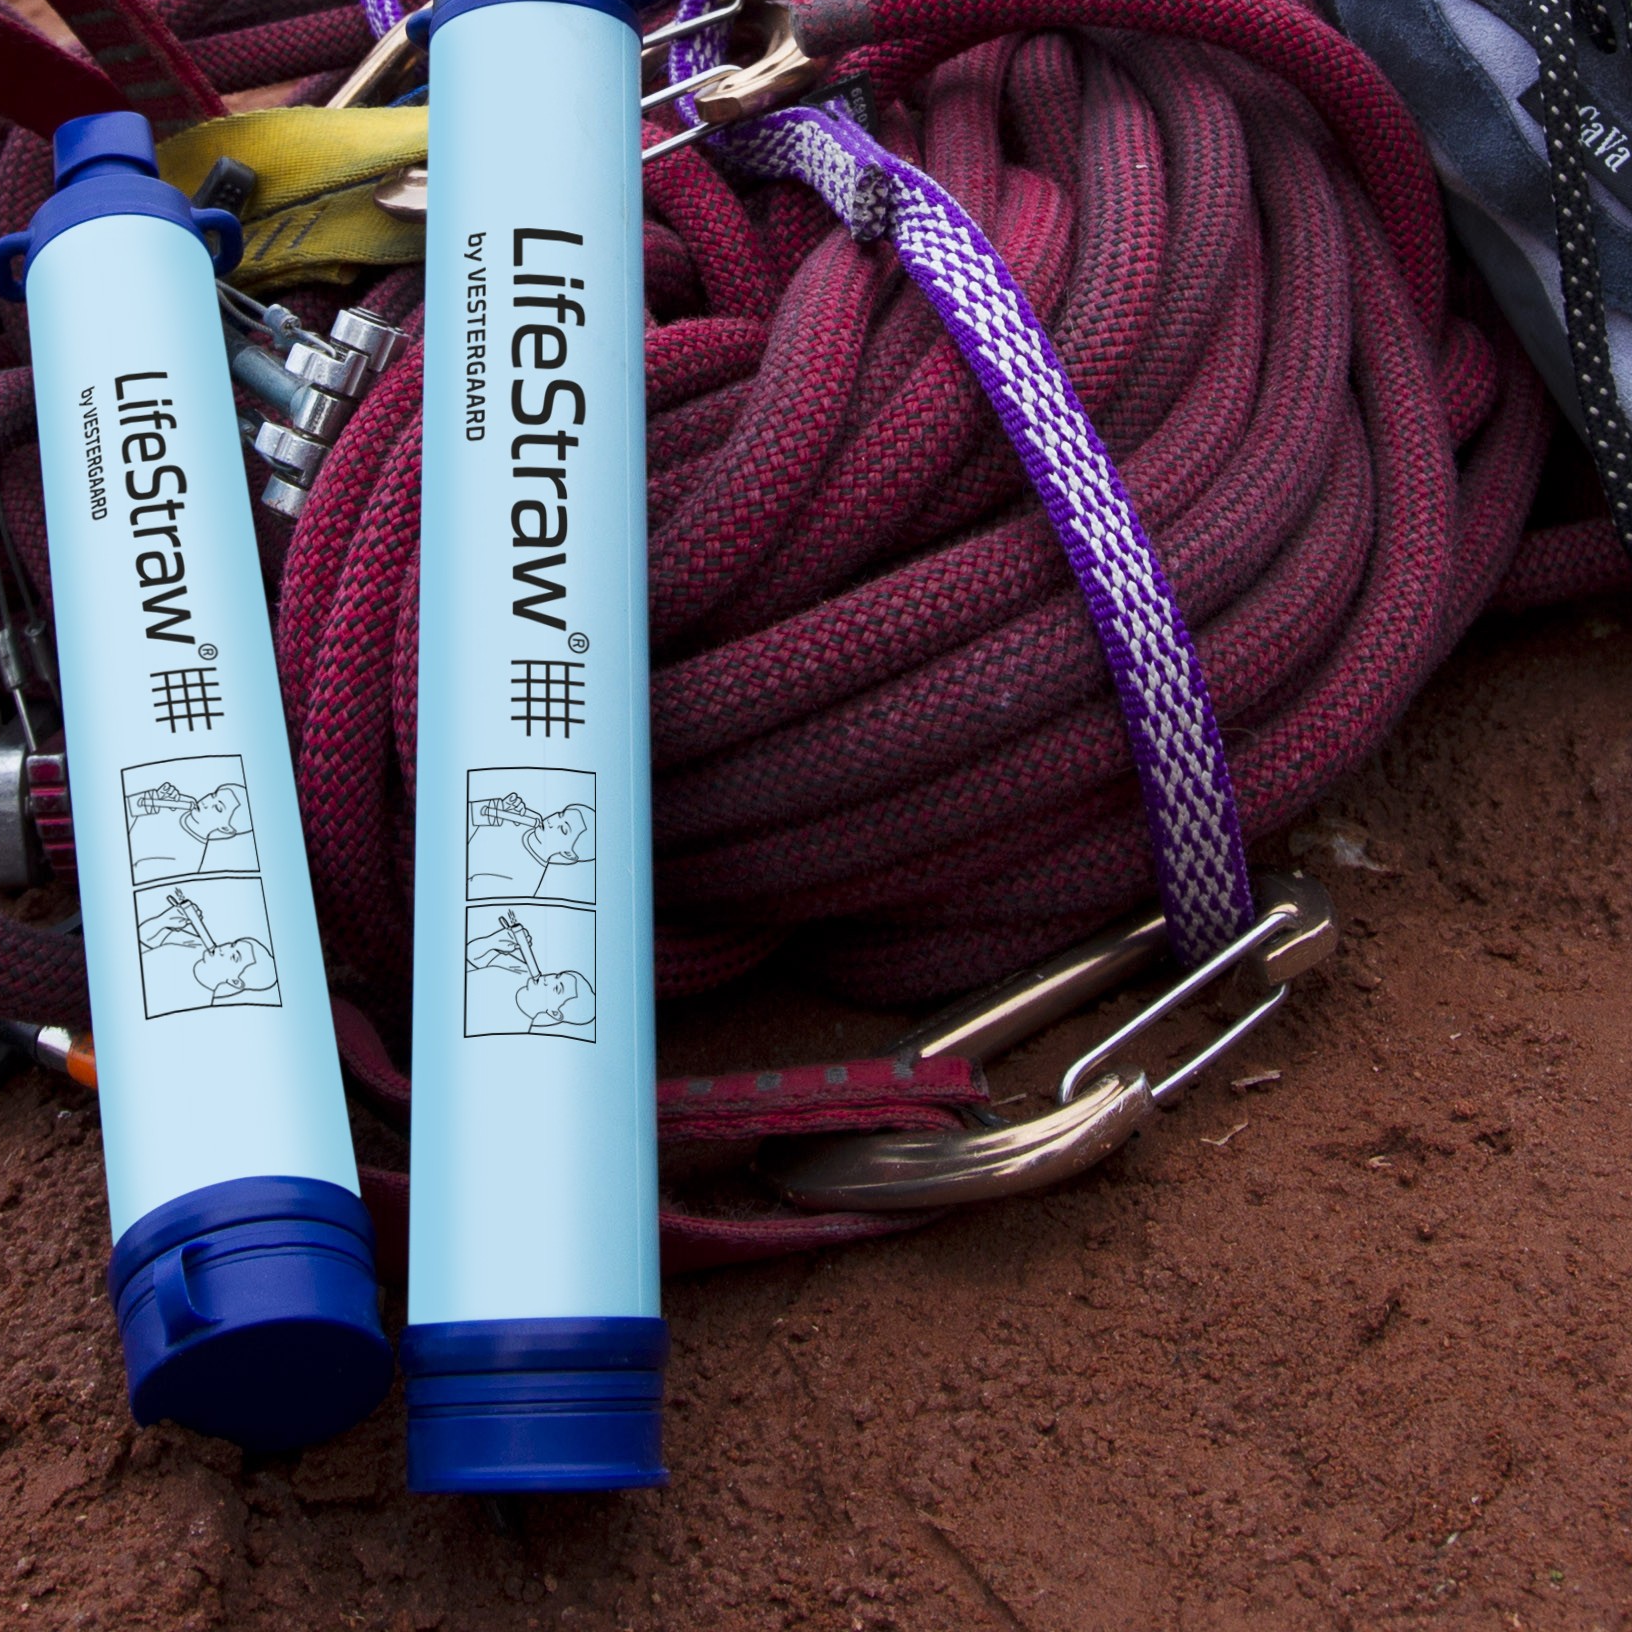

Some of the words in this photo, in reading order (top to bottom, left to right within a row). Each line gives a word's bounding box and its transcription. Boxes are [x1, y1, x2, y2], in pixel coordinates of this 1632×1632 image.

[464, 232, 487, 261] by
[466, 267, 487, 442] VESTERGAARD
[79, 385, 95, 406] by
[83, 407, 108, 521] VESTERGAARD
